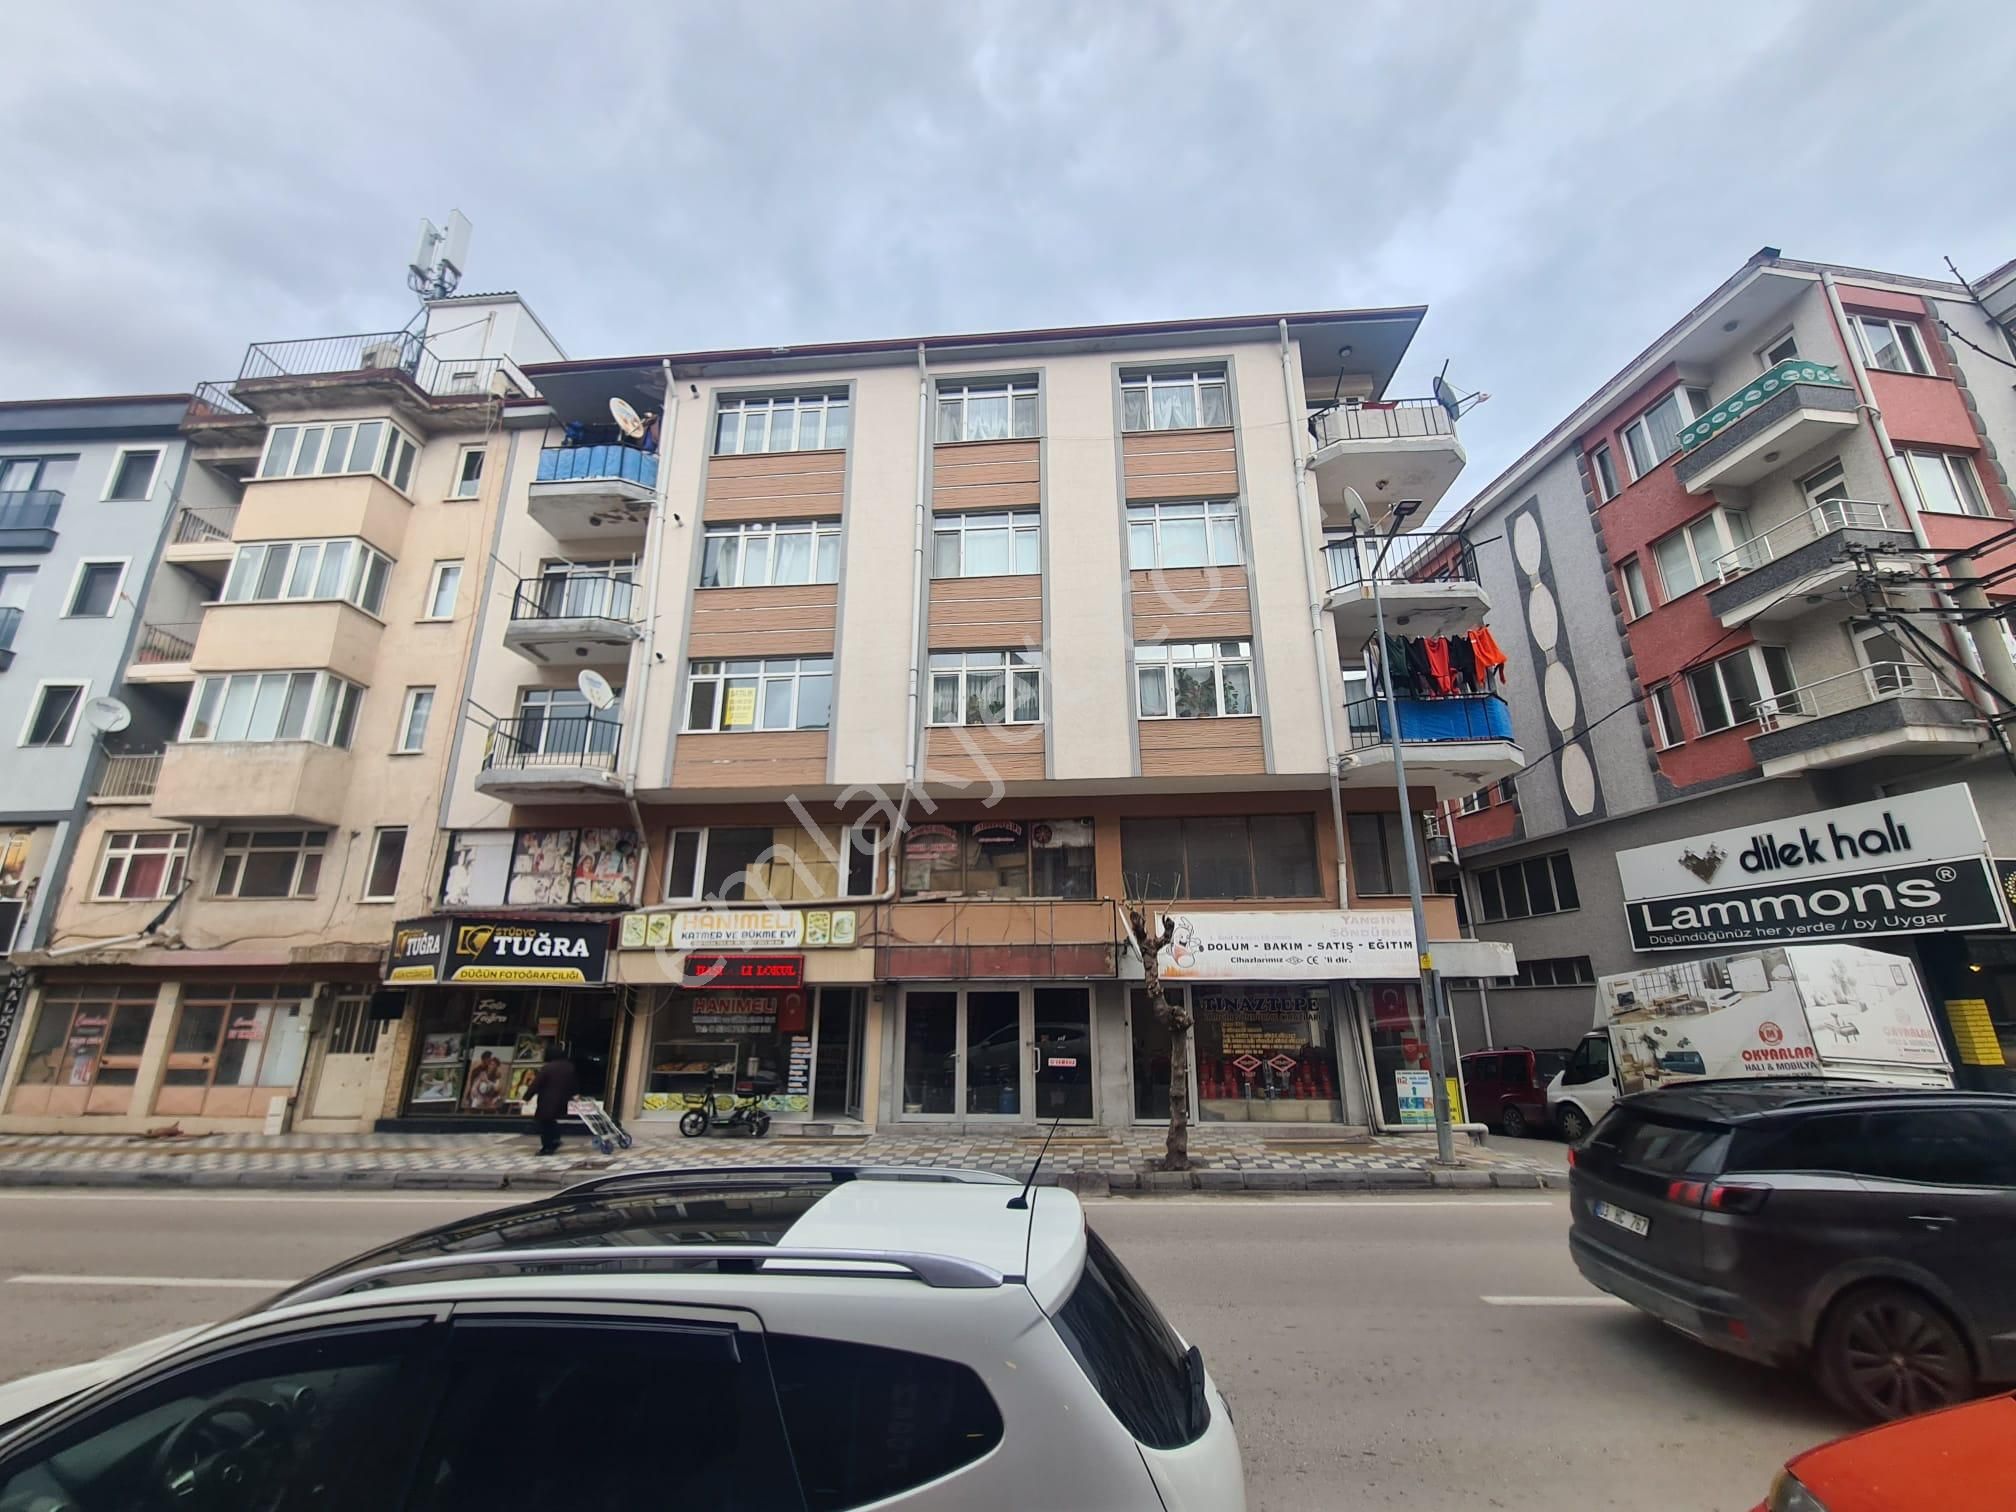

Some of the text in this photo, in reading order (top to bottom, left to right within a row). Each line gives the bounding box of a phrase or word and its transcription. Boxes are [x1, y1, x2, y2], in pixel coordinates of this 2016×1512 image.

[1739, 811, 1911, 873] dilek halı
[1641, 878, 1942, 932] Lammons
[1649, 929, 1751, 946] Düşündüğünüz
[1756, 924, 1781, 938] her
[1787, 920, 1836, 938] yerde
[1854, 917, 1877, 932] by
[1884, 913, 1947, 929] Uygar
[406, 932, 441, 957] TUĞRA
[493, 933, 590, 958] TUĞRA
[1207, 942, 1249, 951] DOLUM
[1263, 942, 1303, 951] BAKIM
[1317, 941, 1354, 953] SATIŞ
[460, 969, 580, 981] DÜĞÜN FOTOĞRAFÇILIĞI
[1745, 1063, 1766, 1072] HALI
[1776, 1061, 1818, 1071] MOBİLYA
